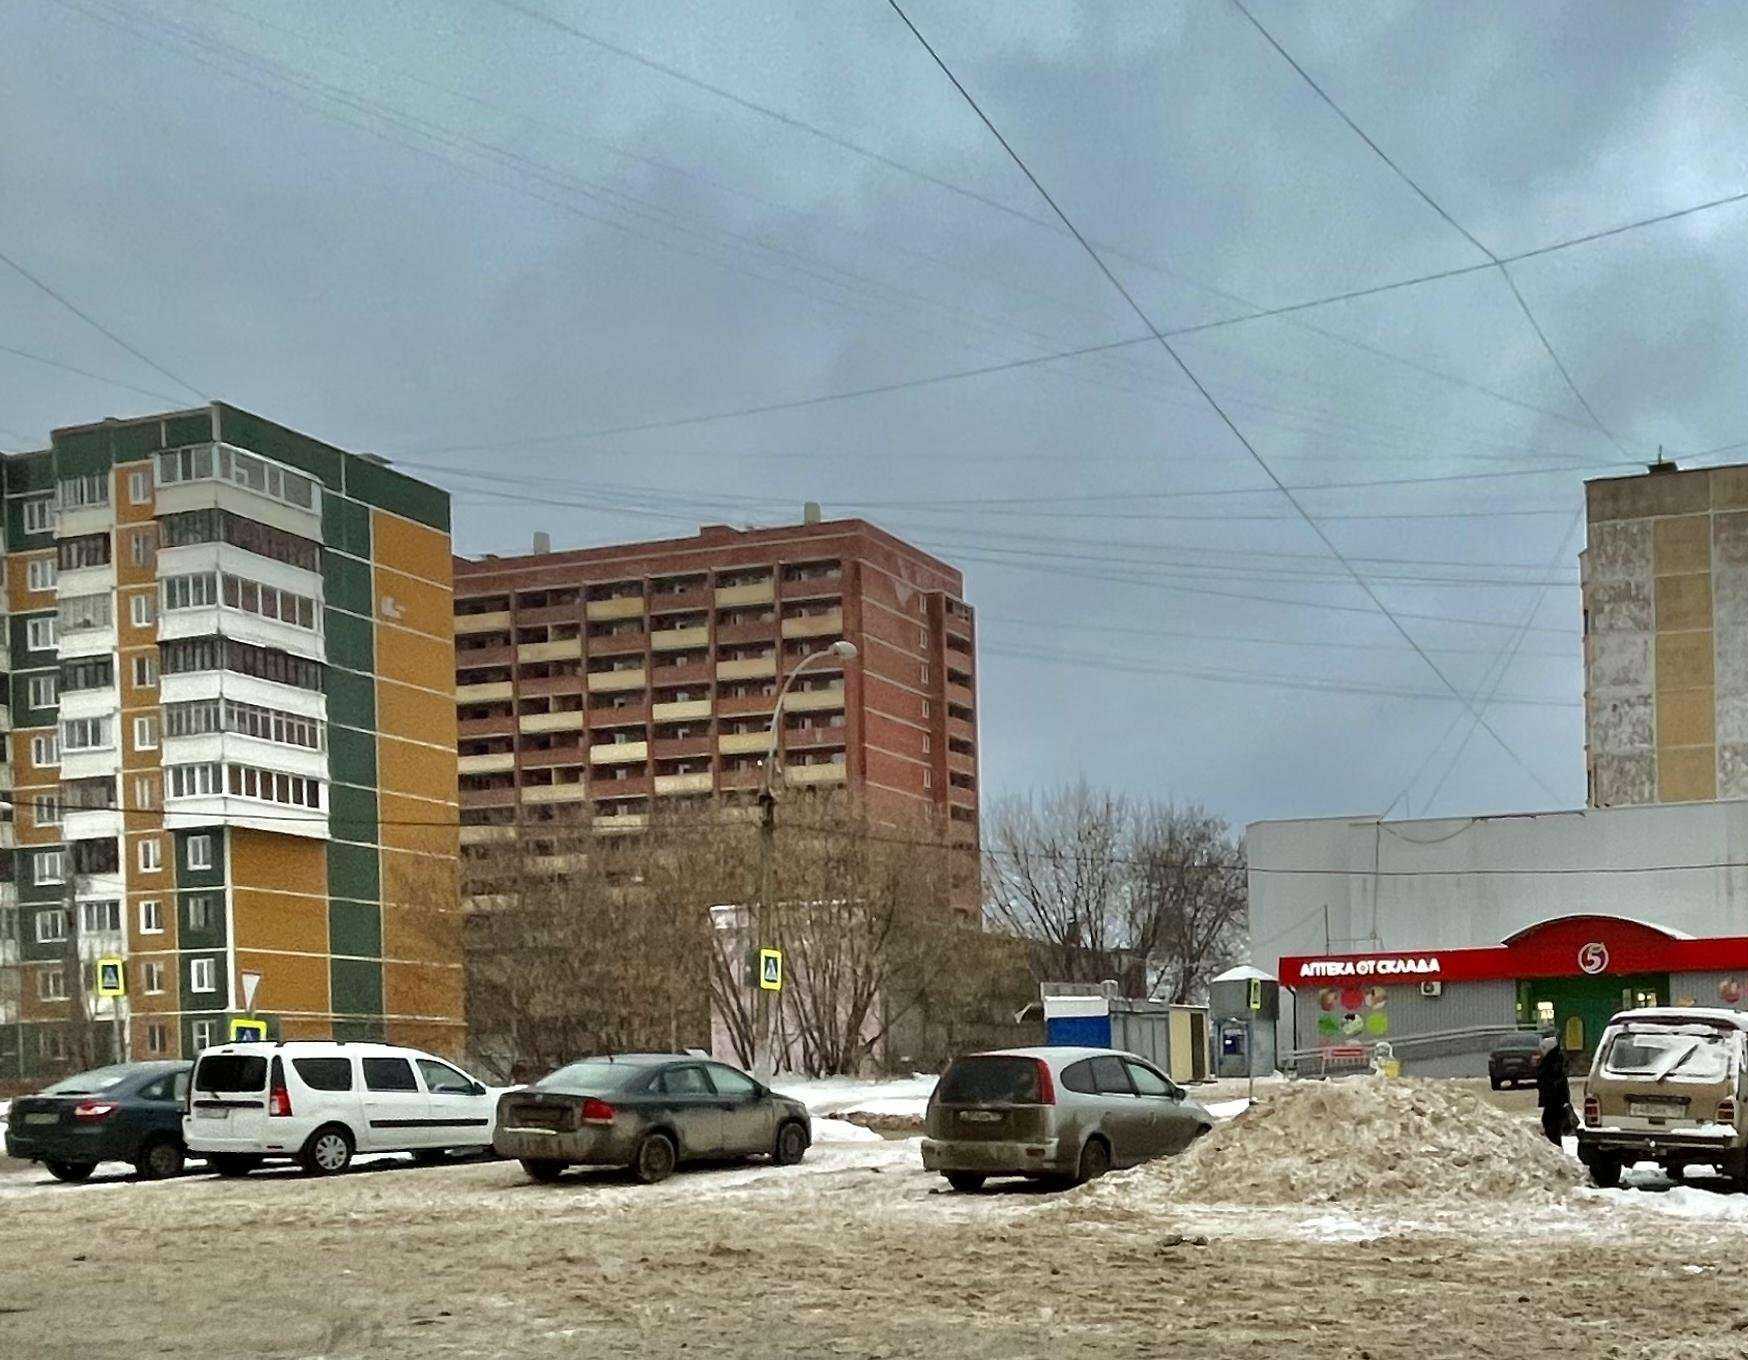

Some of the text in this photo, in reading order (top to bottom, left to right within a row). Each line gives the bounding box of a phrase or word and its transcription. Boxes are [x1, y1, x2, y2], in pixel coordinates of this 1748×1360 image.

[1300, 958, 1440, 977] АПТЕКА ОТ СКЛАДА
